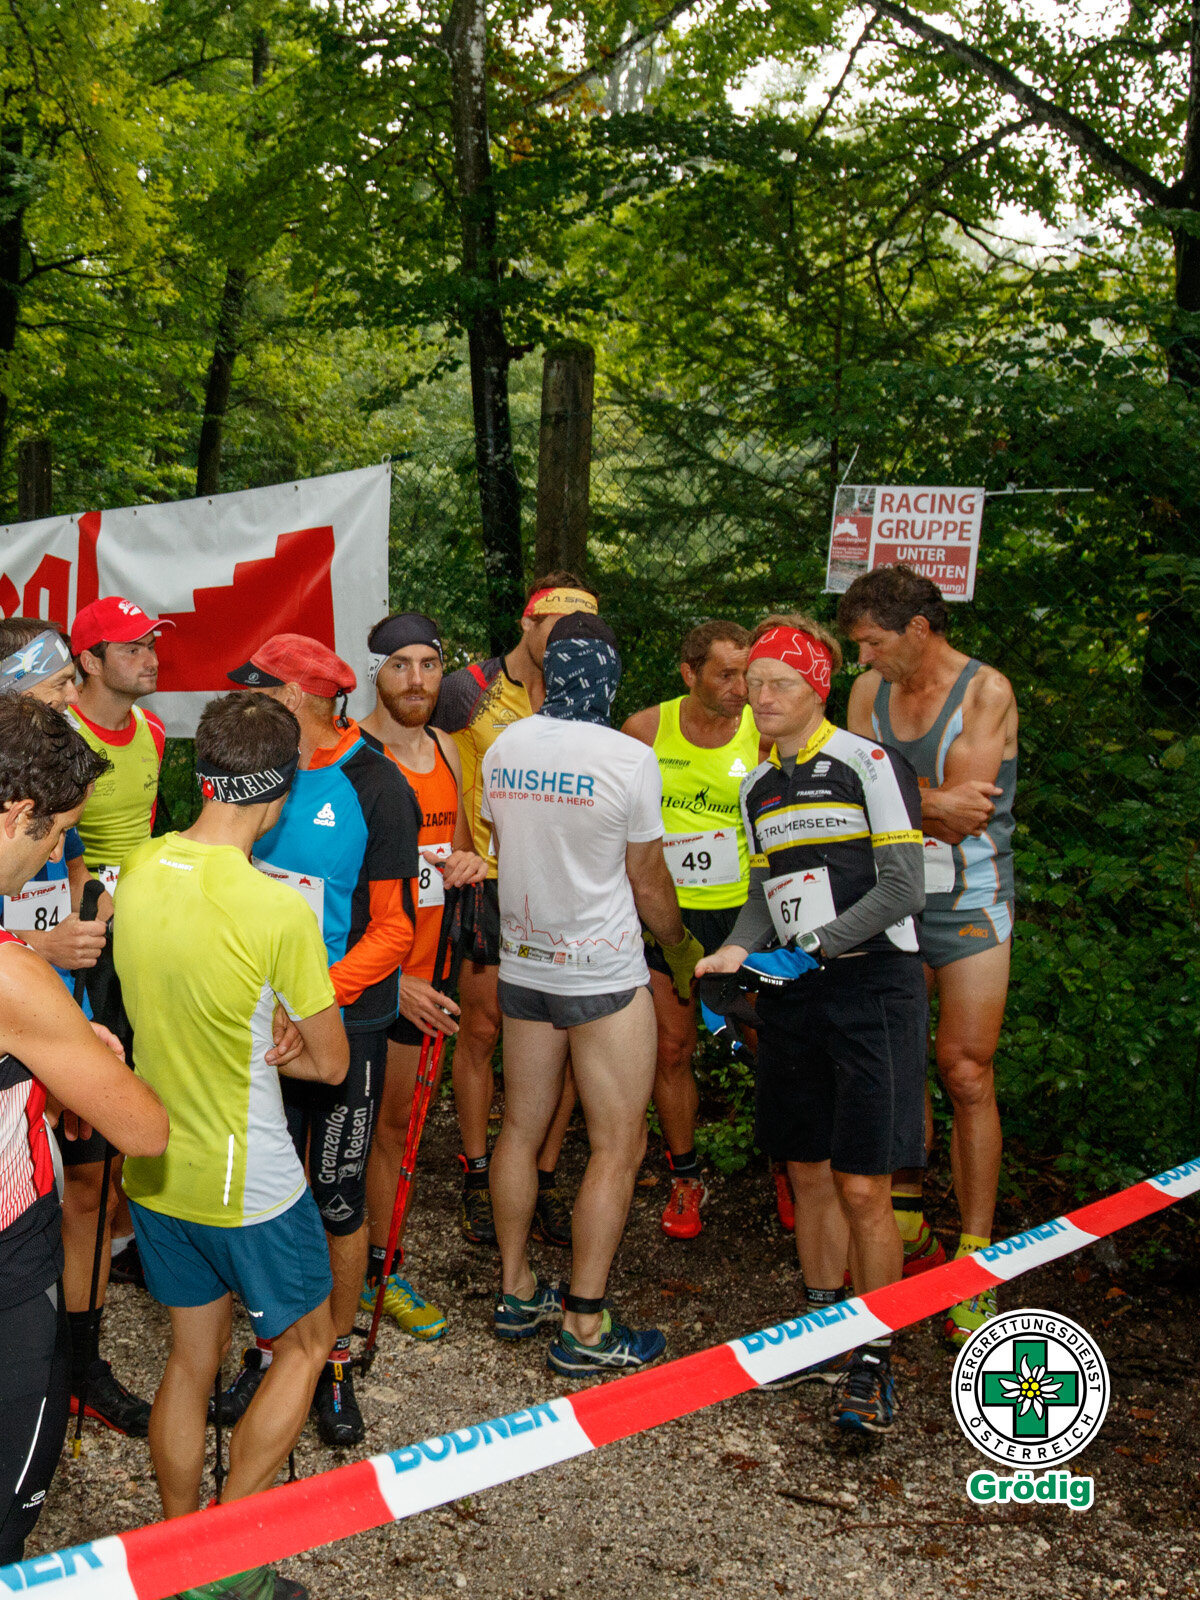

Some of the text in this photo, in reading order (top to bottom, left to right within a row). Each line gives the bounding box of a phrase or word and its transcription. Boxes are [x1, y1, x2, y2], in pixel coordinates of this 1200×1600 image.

[880, 493, 976, 515] RACING
[877, 519, 973, 542] GRUPPE
[896, 546, 946, 562] UNTER
[489, 767, 595, 797] FINISHER
[490, 791, 595, 808] NEVER STOP TO BE A HERO
[681, 851, 712, 872] 49
[34, 906, 60, 932] 84
[781, 897, 802, 924] 67
[318, 1103, 349, 1184] Grenzenlos
[344, 1107, 368, 1160] Reisen
[387, 1402, 560, 1475] BODNER
